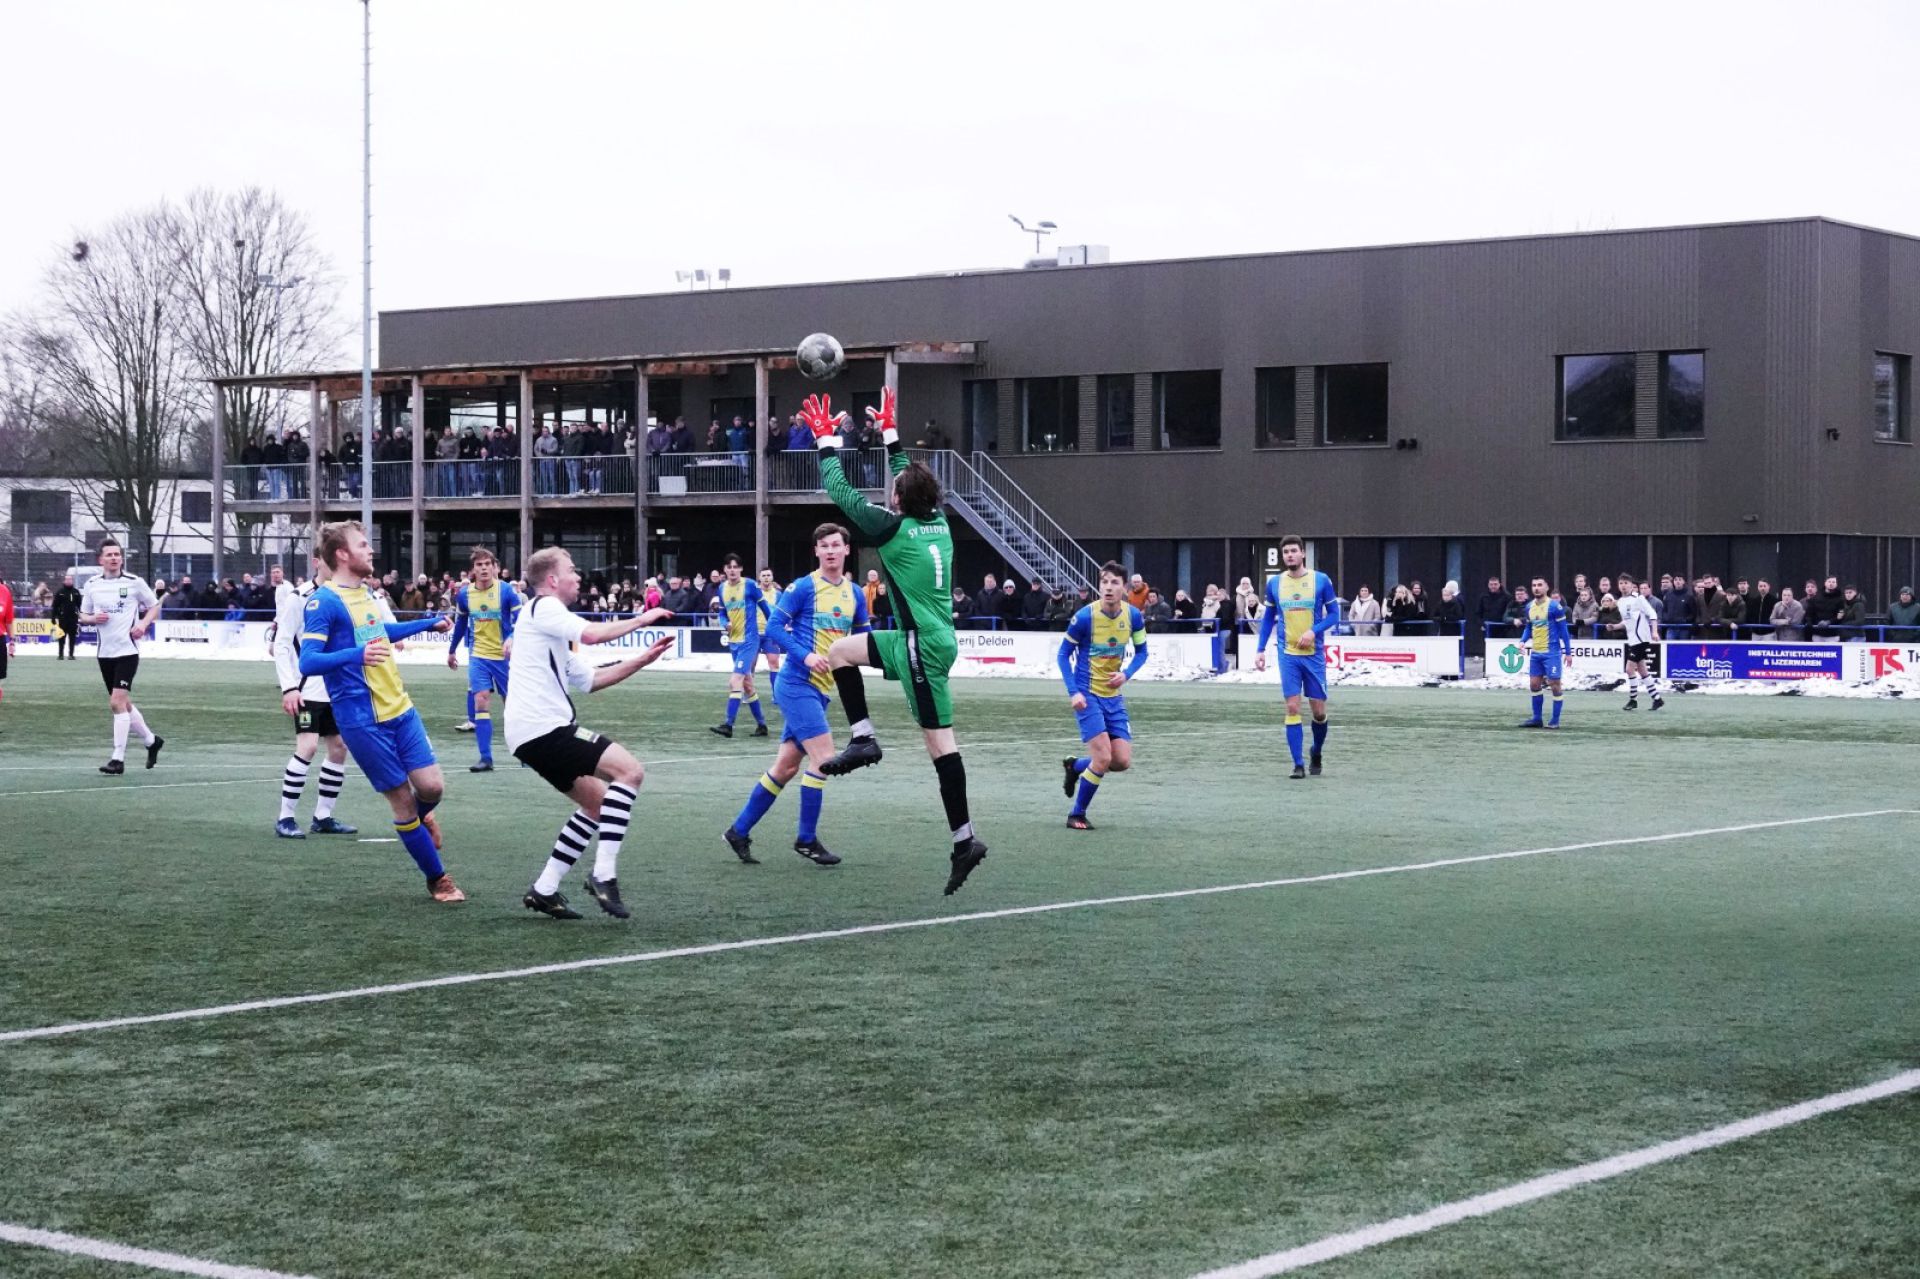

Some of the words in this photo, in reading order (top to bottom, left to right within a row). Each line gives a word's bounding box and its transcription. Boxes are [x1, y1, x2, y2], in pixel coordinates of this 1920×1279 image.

[908, 527, 918, 539] SV
[919, 524, 949, 535] DELDEN
[1267, 547, 1279, 566] 8
[928, 543, 943, 589] 1
[16, 622, 46, 634] DELDEN
[426, 631, 453, 643] Delde
[958, 635, 974, 647] erij
[978, 635, 1014, 646] Delden
[1748, 649, 1837, 659] INSTALLATIETECHNIEK
[1696, 656, 1714, 668] ten
[1763, 658, 1770, 666] &
[1771, 659, 1822, 667] IJZERWAREN
[1869, 648, 1904, 680] TS
[1706, 666, 1732, 678] dam
